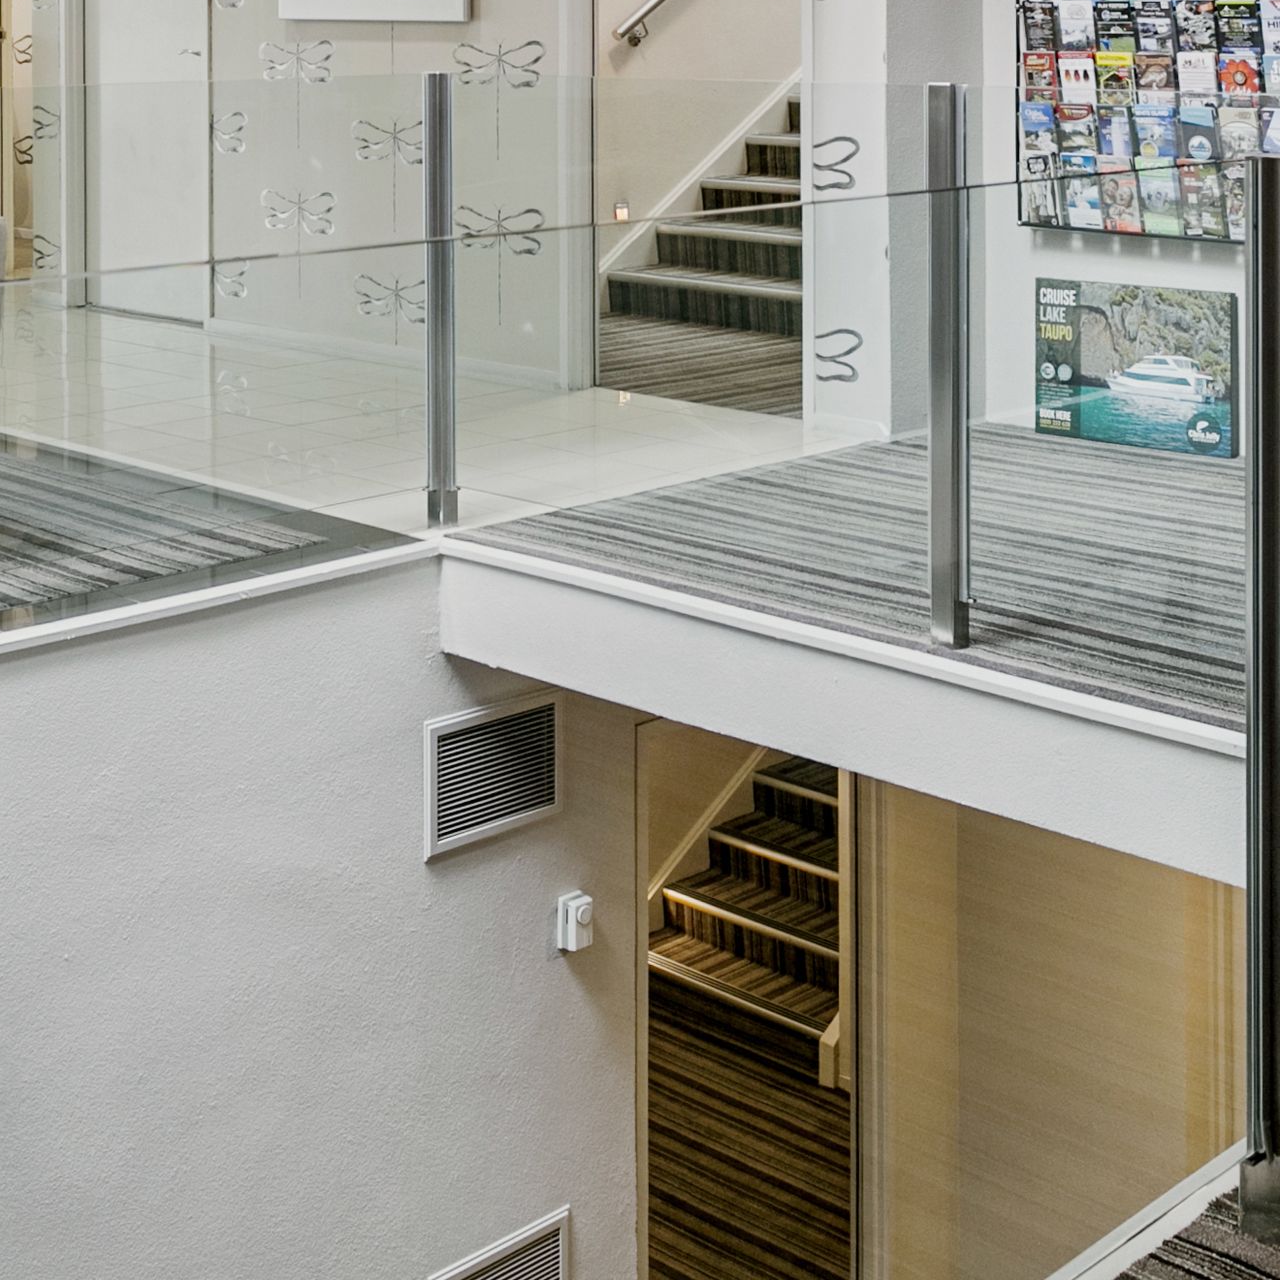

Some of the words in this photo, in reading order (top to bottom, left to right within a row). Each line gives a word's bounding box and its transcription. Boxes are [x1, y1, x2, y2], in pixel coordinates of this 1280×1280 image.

[1039, 287, 1076, 306] CRUISE
[1039, 306, 1066, 323] LAKE
[1039, 324, 1073, 342] TAUPO
